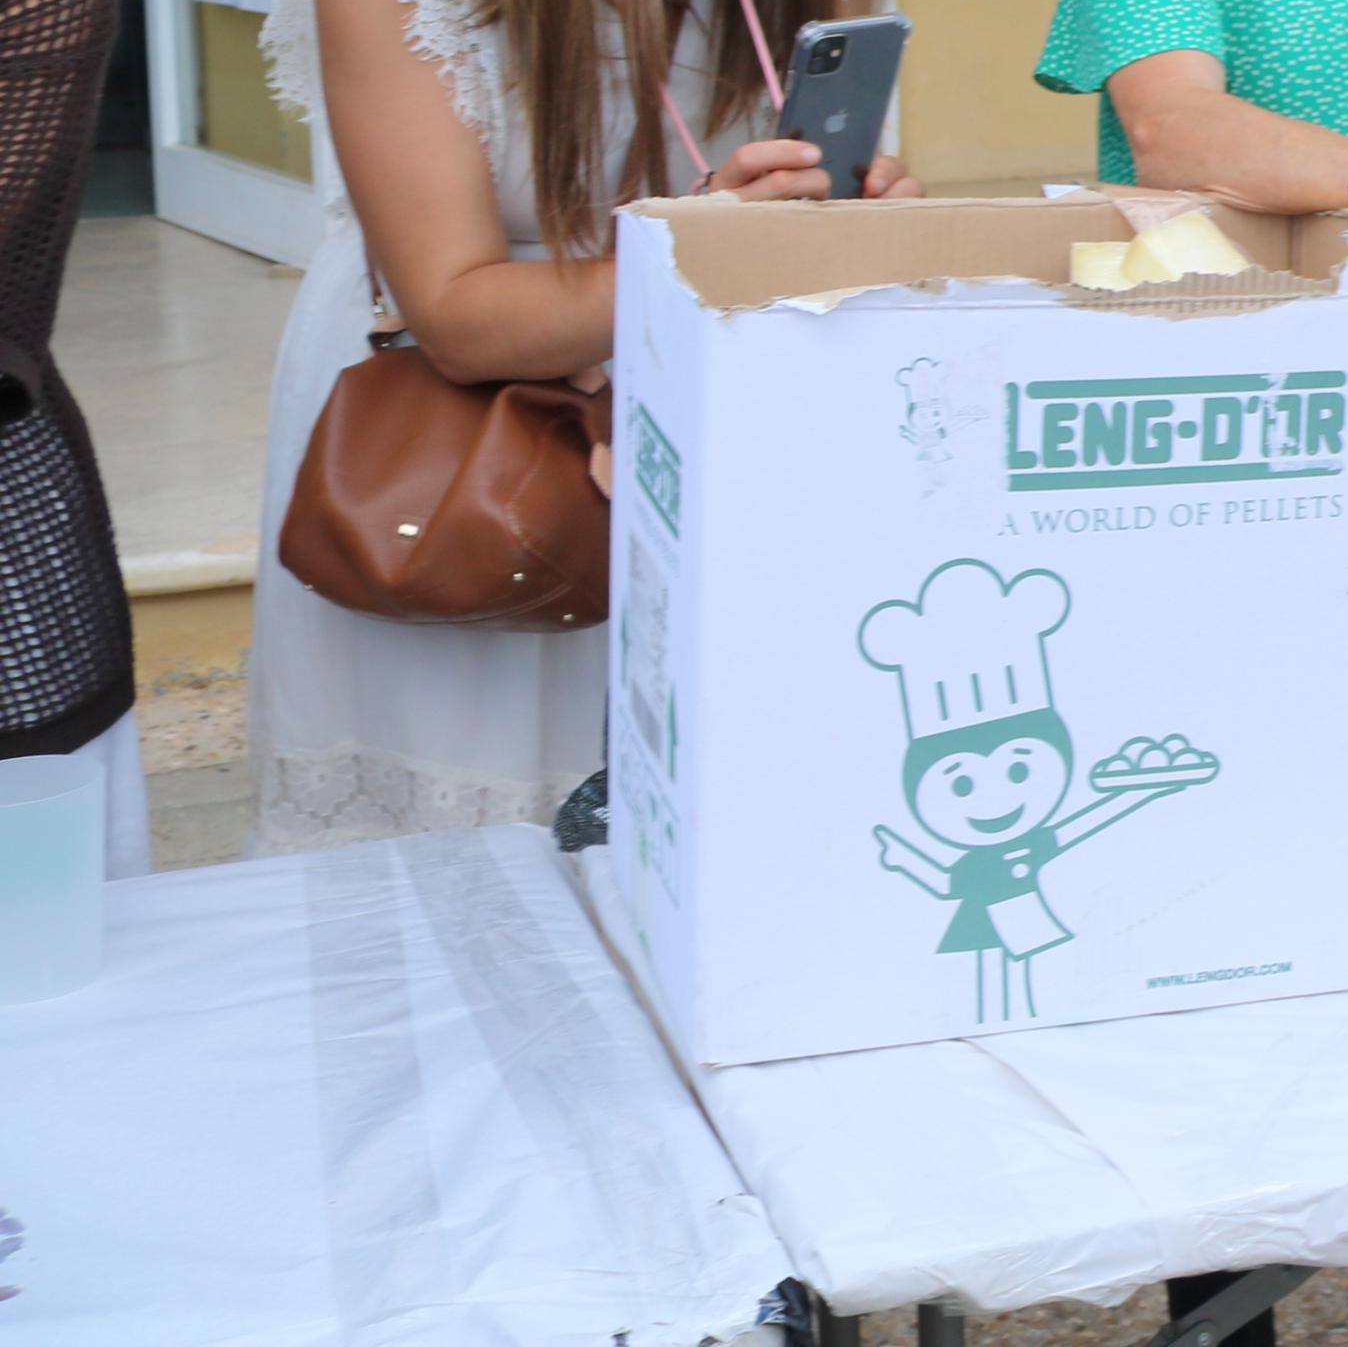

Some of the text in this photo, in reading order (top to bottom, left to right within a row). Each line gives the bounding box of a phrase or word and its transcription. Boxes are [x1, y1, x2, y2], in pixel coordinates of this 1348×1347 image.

[997, 494, 1344, 536] A WORLD OF PELLETS
